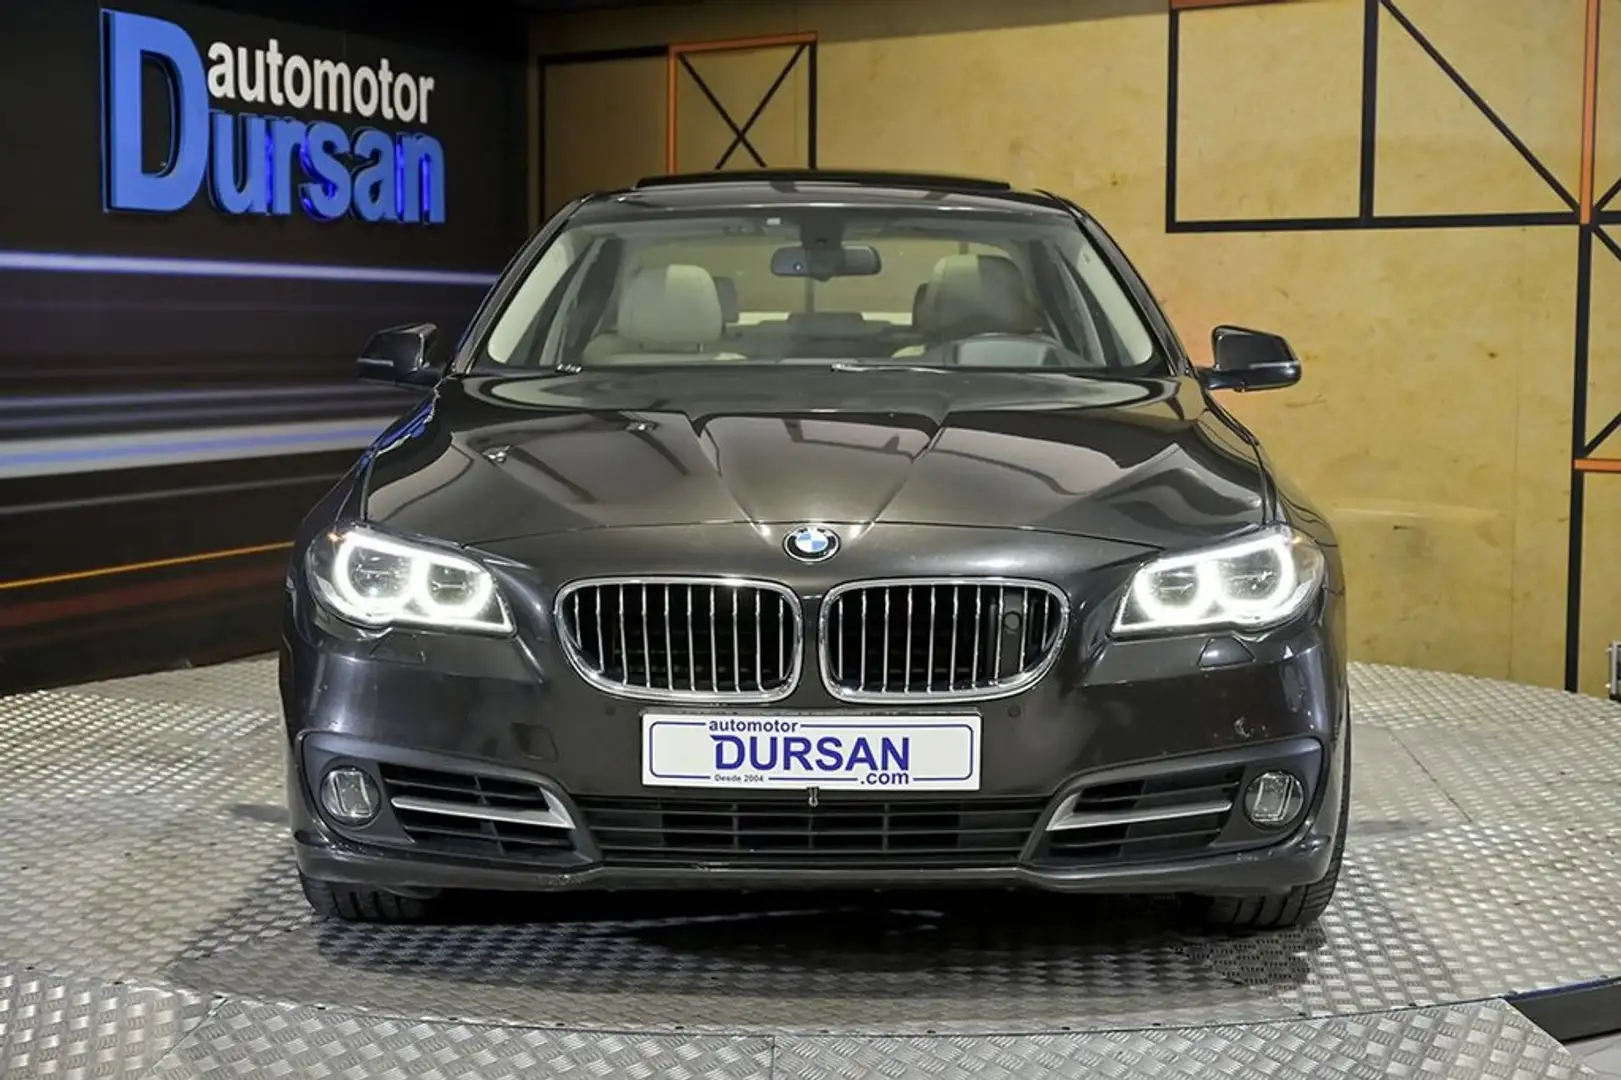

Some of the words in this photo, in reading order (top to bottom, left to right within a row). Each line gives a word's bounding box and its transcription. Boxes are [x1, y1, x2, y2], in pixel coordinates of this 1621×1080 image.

[207, 38, 435, 124] automotor
[100, 8, 446, 225] Dursan
[708, 718, 799, 733] automotor
[709, 734, 910, 772] DURSAN
[714, 773, 742, 782] Desde
[859, 770, 910, 785] .com
